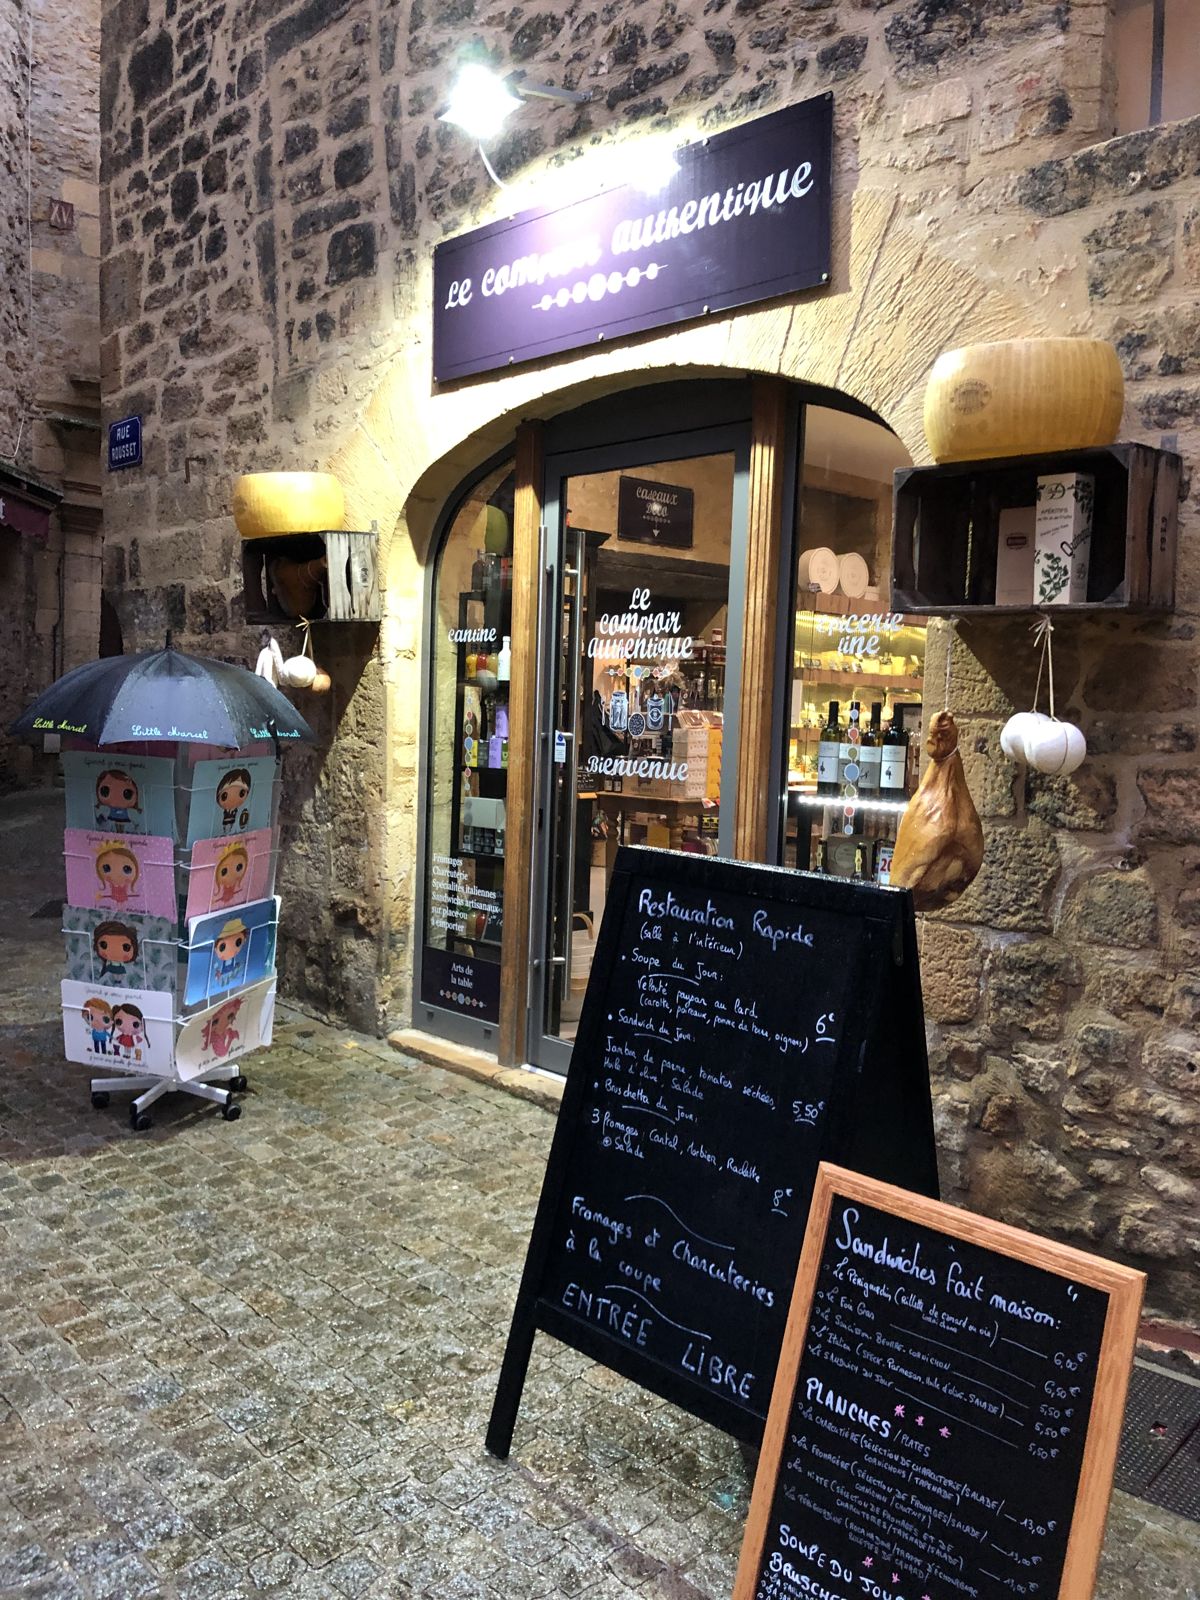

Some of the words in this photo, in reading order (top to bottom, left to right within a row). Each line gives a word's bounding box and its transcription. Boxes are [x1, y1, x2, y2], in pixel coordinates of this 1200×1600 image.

[116, 424, 130, 441] RUE
[629, 587, 651, 611] Le
[587, 636, 693, 660] authentique
[131, 724, 162, 738] Little
[168, 724, 209, 740] Marcel
[586, 755, 690, 781] Bienvenue
[432, 865, 469, 881] Charcuterie
[433, 853, 463, 867] Fromages
[465, 884, 497, 900] italiennes
[638, 888, 733, 929] Restauration
[752, 909, 813, 950] Rapide
[639, 921, 661, 940] (salle
[672, 931, 678, 942] à
[688, 931, 742, 959] l'intérieur)
[451, 963, 464, 974] Arts
[465, 965, 474, 976] de
[631, 947, 660, 970] Soupe
[671, 957, 684, 970] du
[457, 976, 473, 989] table
[637, 974, 667, 995] Velouté
[676, 990, 707, 1011] paysan
[714, 1000, 726, 1010] au
[734, 998, 757, 1018] lard
[618, 1008, 654, 1030] Sandwich
[658, 1021, 669, 1035] du
[737, 1020, 748, 1031] de
[642, 1048, 653, 1063] de
[699, 1066, 732, 1088] tomates
[604, 1078, 649, 1104] Bruschetta
[655, 1095, 667, 1110] du
[671, 1077, 703, 1099] Salade
[591, 1108, 599, 1123] 3
[726, 1157, 760, 1182] Raclette
[614, 1136, 644, 1158] Salade
[565, 1229, 574, 1249] à
[588, 1237, 601, 1260] la
[619, 1261, 660, 1291] coupe
[572, 1195, 631, 1243] Fromages
[644, 1228, 660, 1246] et
[672, 1240, 773, 1306] Charcuteries
[835, 1207, 935, 1285] Sandwiches
[946, 1261, 983, 1300] fait
[989, 1294, 1060, 1329] maison:
[562, 1282, 652, 1345] ENTRÉE
[826, 1286, 838, 1302] Le
[840, 1296, 853, 1311] Foie
[856, 1301, 874, 1320] Gras
[928, 1303, 938, 1318] de
[806, 1377, 891, 1437] PLANCHES
[900, 1433, 930, 1457] PLATES
[779, 1524, 826, 1567] SOUPE
[829, 1559, 852, 1582] DU
